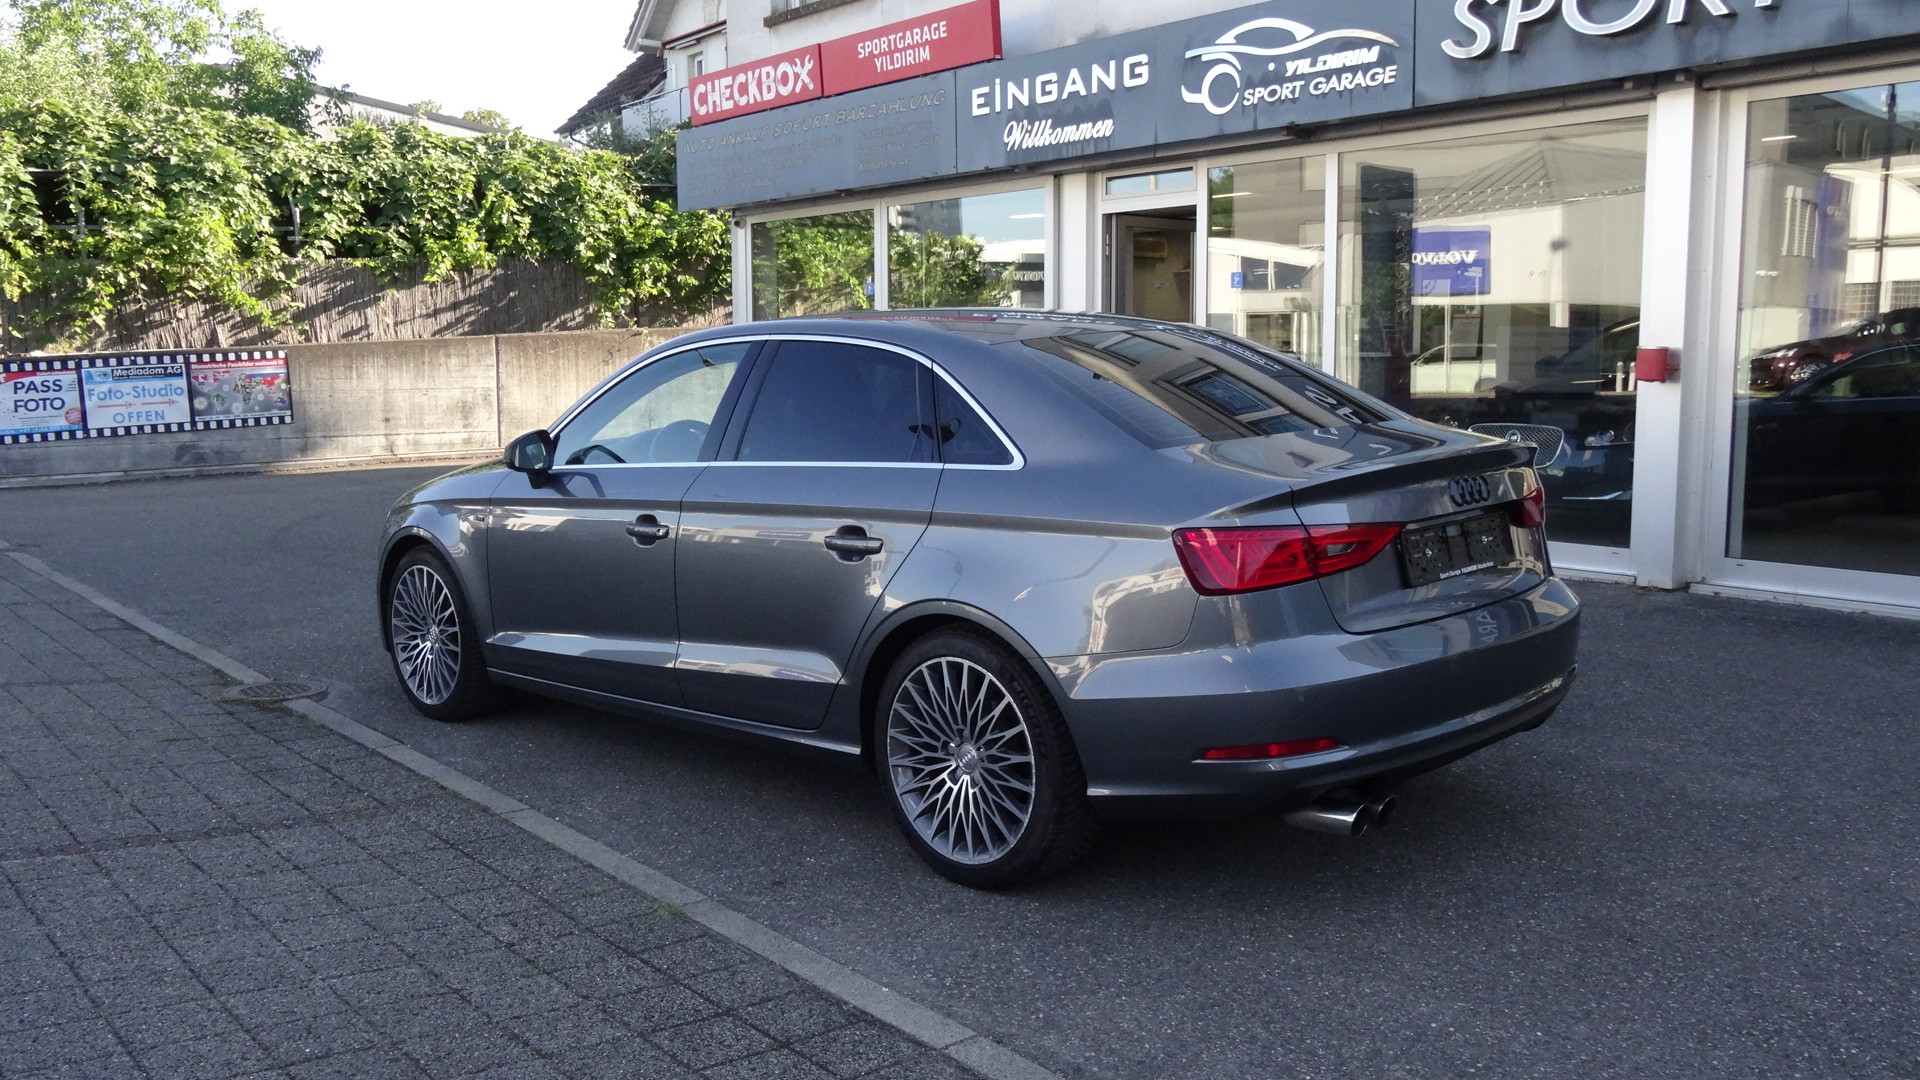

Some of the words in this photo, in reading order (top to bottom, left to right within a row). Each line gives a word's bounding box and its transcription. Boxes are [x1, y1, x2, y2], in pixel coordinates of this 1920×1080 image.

[857, 21, 947, 59] SPORTGARAGE
[1440, 0, 1783, 59] SPO
[874, 46, 930, 73] YILDIRIM
[1285, 46, 1380, 76] YILDIRIM
[693, 53, 814, 116] CHECKBOX
[1242, 82, 1305, 107] SPORT
[1309, 65, 1397, 97] GARAGE
[683, 137, 716, 154] AUTO
[718, 126, 770, 148] ANKAUF
[773, 113, 832, 137] SOFORT
[836, 88, 946, 125] BARZAHLUNG
[1003, 119, 1114, 152] Willkommen
[113, 367, 164, 377] Mediadom
[166, 365, 182, 374] AG
[13, 379, 63, 395] PASS
[87, 383, 184, 402] Foto-Studio
[14, 397, 65, 413] FOTO
[112, 409, 165, 424] OFFEN
